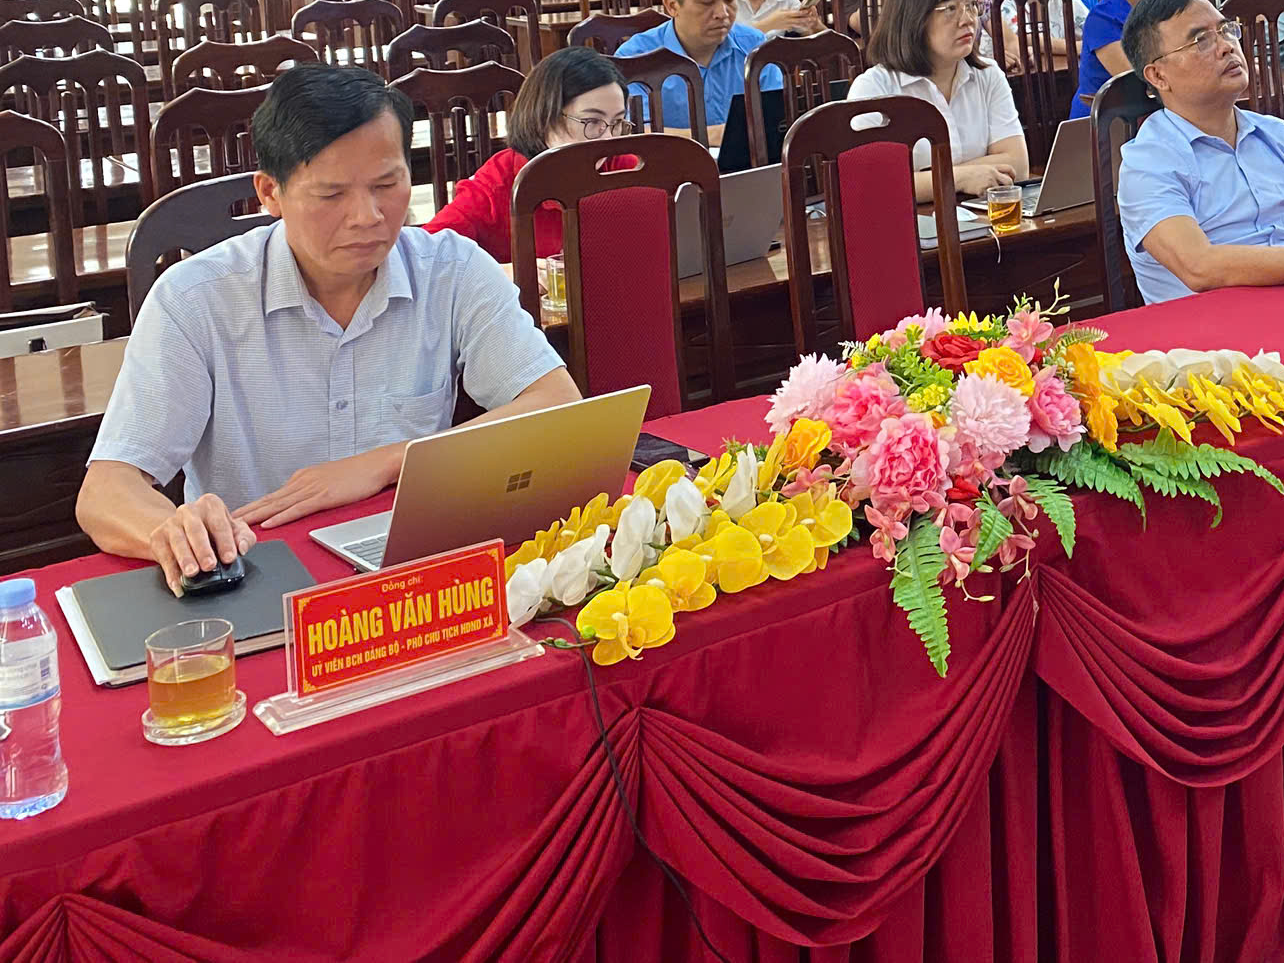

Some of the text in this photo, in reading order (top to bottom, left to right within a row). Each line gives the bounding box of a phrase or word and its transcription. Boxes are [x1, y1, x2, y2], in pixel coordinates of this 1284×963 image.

[307, 576, 494, 656] HOÀNG VĂN HÙNG
[345, 652, 363, 669] BCH
[442, 624, 460, 642] TỊCH
